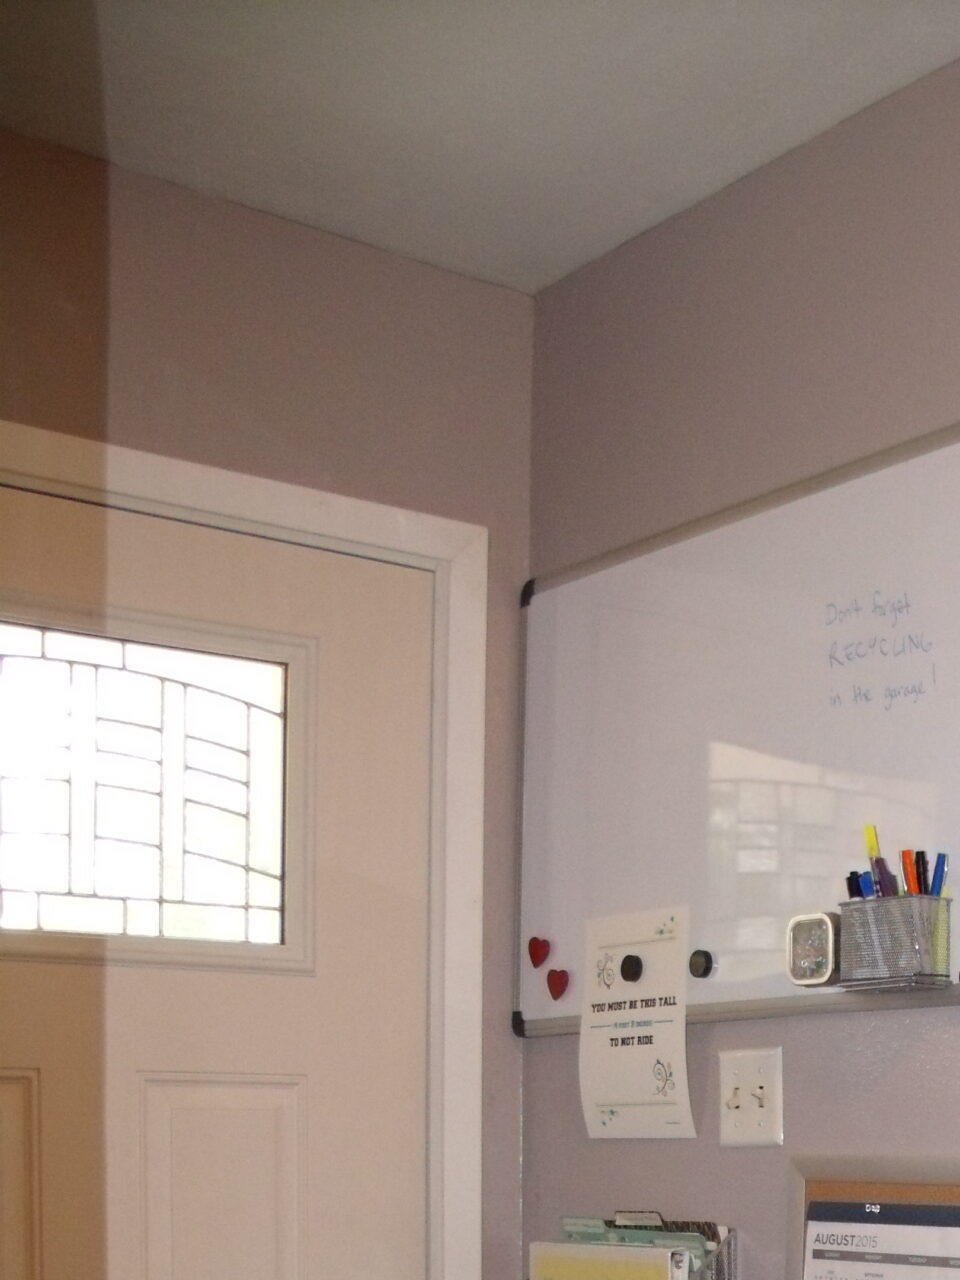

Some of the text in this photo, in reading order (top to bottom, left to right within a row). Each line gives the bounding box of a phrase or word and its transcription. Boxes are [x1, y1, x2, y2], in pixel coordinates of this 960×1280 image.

[829, 633, 934, 668] RECYCLING
[591, 996, 677, 1013] YOU MUST BE THIS TALL
[609, 1035, 654, 1047] TO NOT RIDE
